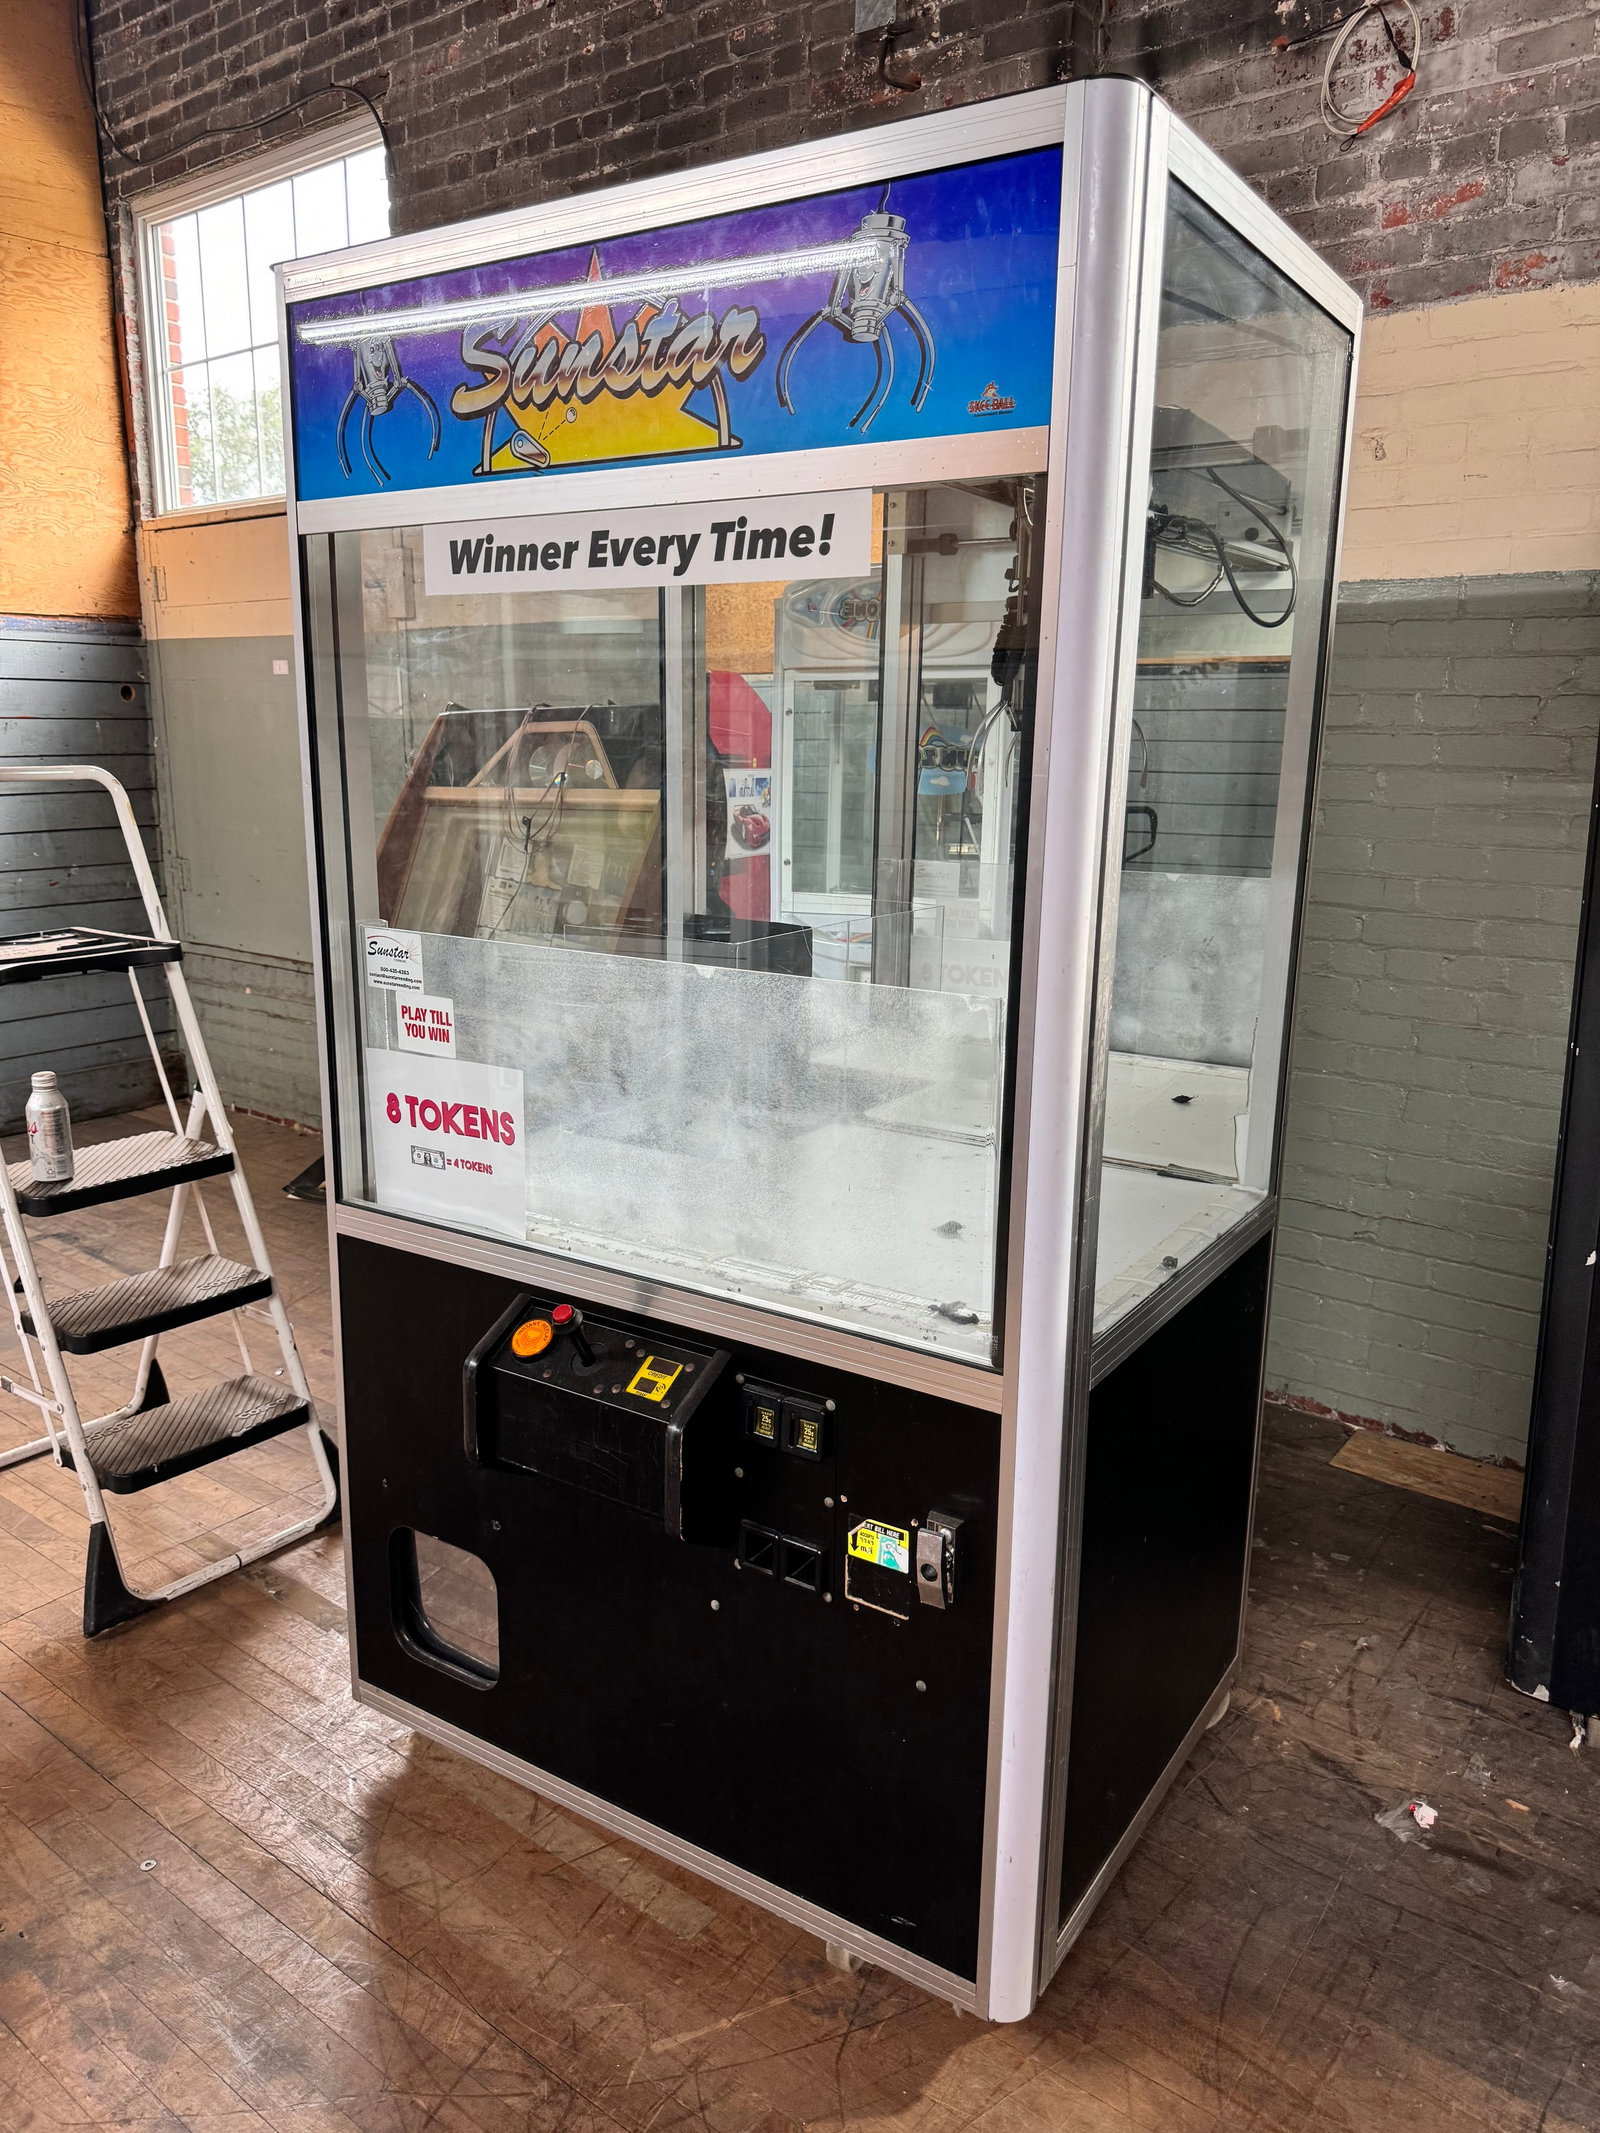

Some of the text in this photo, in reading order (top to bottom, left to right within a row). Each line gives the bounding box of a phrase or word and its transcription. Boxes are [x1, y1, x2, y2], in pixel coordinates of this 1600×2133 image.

[450, 298, 766, 420] Sunstar
[449, 513, 835, 577] Winner Every Time!
[367, 941, 409, 959] Sunstar
[401, 1005, 452, 1027] PLAY TILL
[404, 1022, 450, 1043] YOU WIN
[386, 1092, 516, 1146] 8 TOKENS
[453, 1158, 459, 1169] 4
[460, 1159, 493, 1175] TOKENS
[647, 1371, 667, 1380] CREDIT
[874, 1526, 885, 1535] BILL
[886, 1530, 900, 1540] HERE
